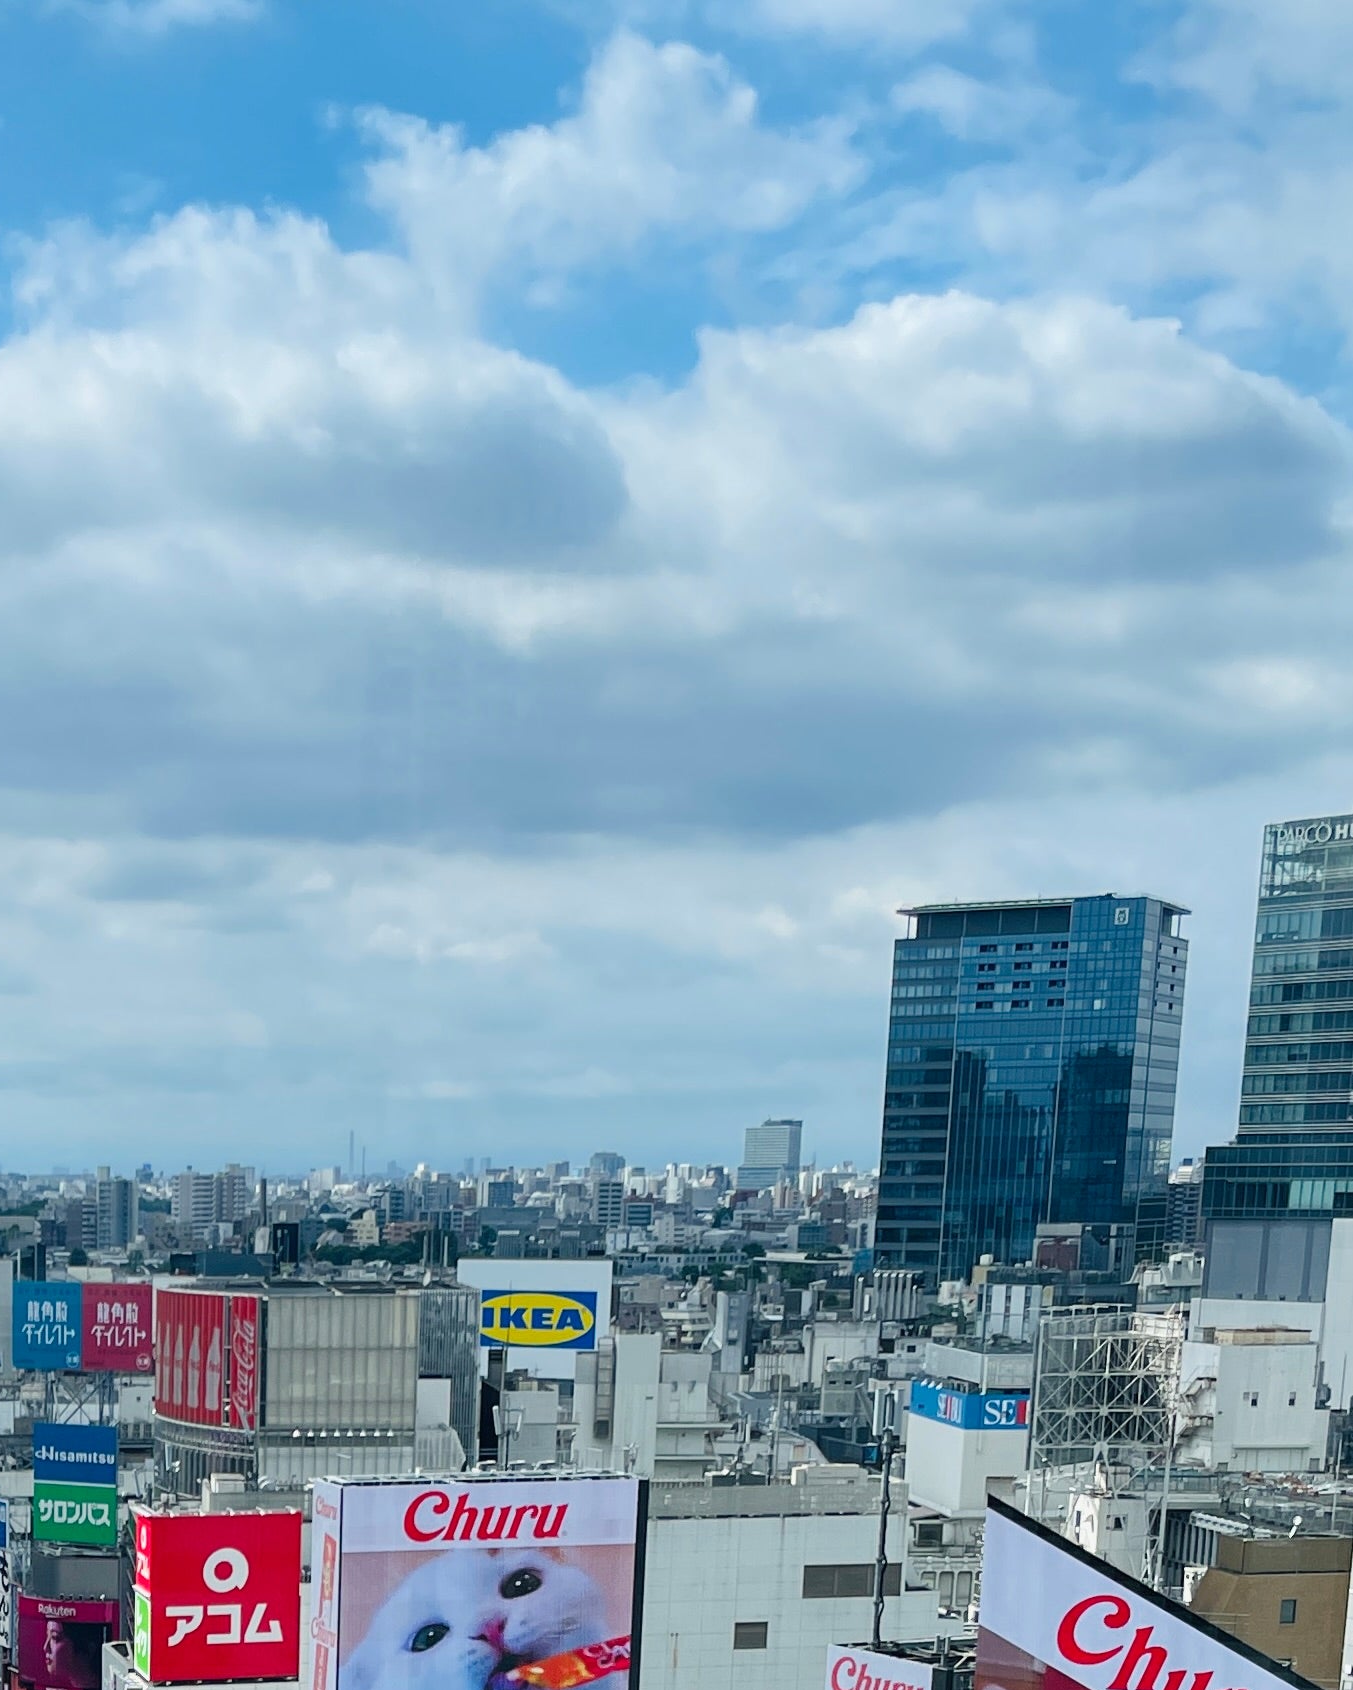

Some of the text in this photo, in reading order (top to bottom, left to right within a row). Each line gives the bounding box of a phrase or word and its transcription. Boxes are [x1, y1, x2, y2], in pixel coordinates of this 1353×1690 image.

[1277, 823, 1332, 843] PARCO
[27, 1301, 68, 1323] 龍角散
[96, 1302, 139, 1324] 龍角散
[482, 1307, 585, 1330] IKEA
[21, 1324, 76, 1345] ダイレクト
[90, 1324, 146, 1347] ダイレクト
[35, 1446, 115, 1464] Hisamitsu
[38, 1499, 111, 1527] サロンパス
[403, 1490, 568, 1542] Churu
[38, 1604, 77, 1617] Rakuten
[165, 1603, 284, 1647] アコム
